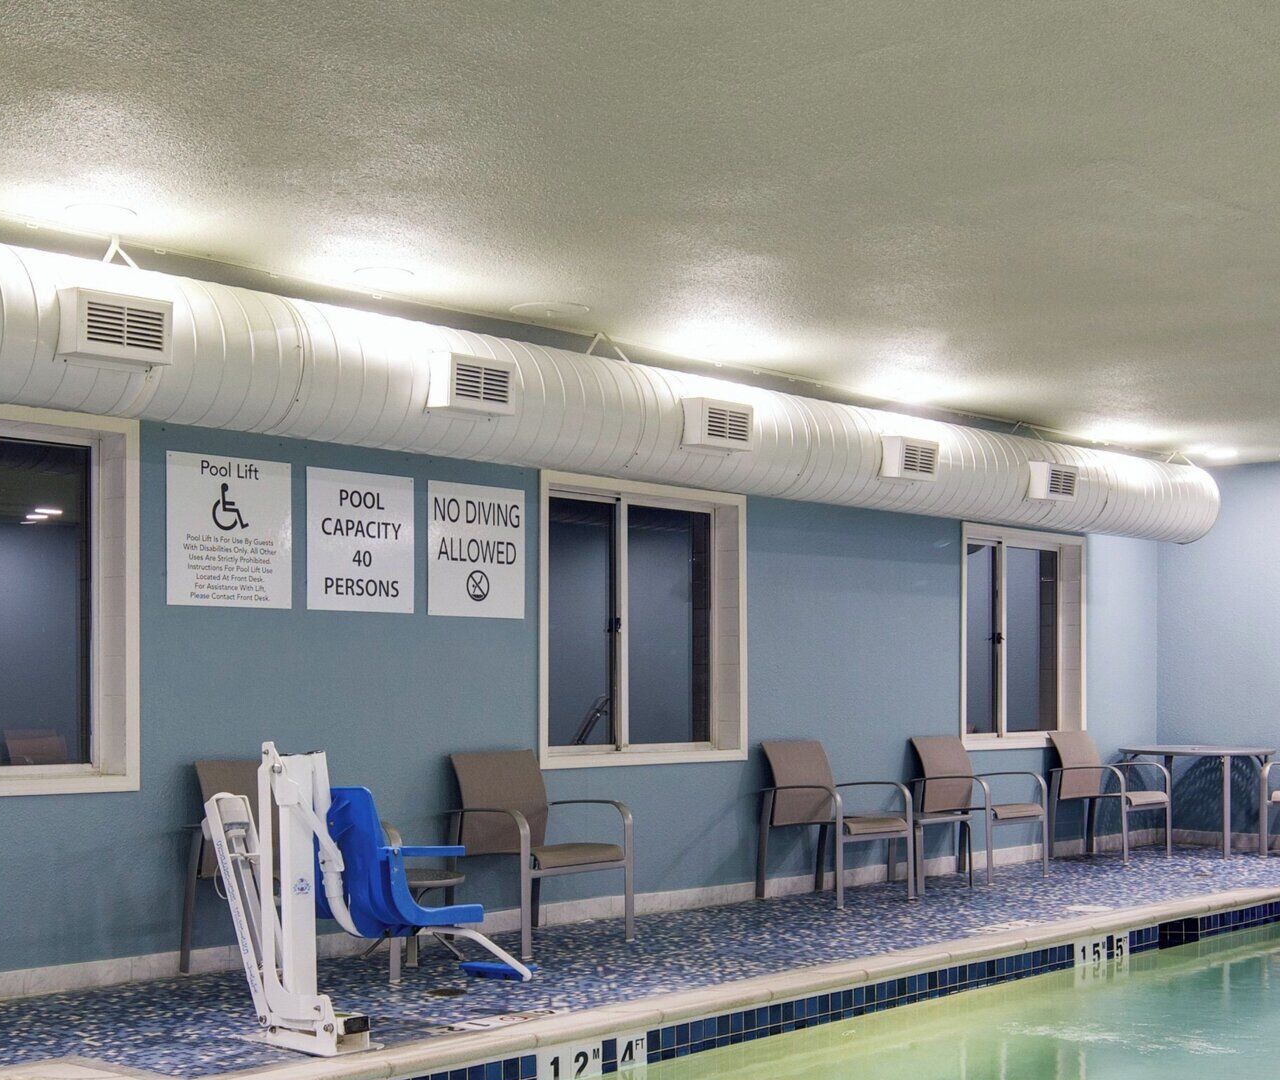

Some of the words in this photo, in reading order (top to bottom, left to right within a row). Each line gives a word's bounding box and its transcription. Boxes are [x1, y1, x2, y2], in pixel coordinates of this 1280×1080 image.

[201, 460, 231, 477] Pool
[237, 464, 259, 480] Lift
[339, 489, 385, 510] POOL
[434, 496, 460, 522] NO
[465, 500, 520, 528] DIVING
[321, 517, 402, 540] CAPACITY
[200, 544, 232, 553] Disabilities
[220, 536, 230, 544] For
[244, 538, 252, 546] By
[217, 555, 238, 564] Strictly
[352, 550, 372, 567] 40
[437, 536, 517, 565] ALLOWED
[187, 563, 223, 571] Instructions
[206, 583, 238, 591] Assistance
[324, 577, 400, 598] PERSONS
